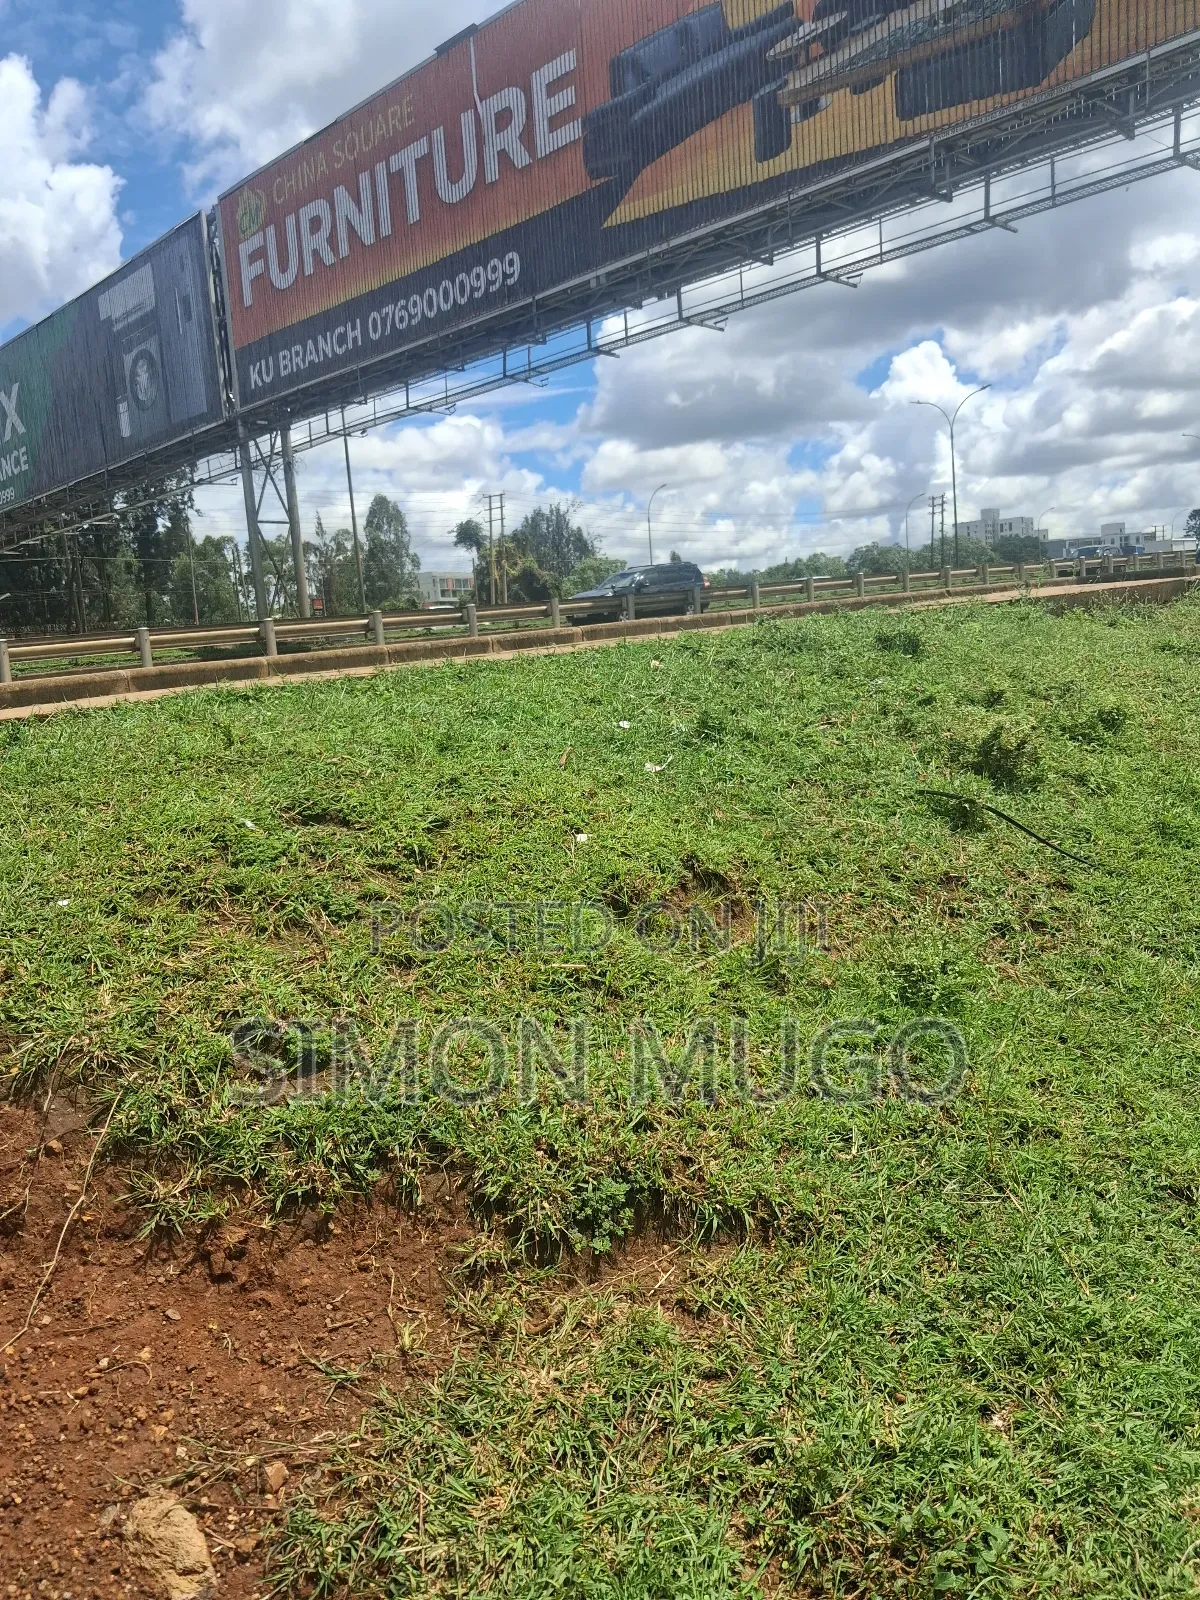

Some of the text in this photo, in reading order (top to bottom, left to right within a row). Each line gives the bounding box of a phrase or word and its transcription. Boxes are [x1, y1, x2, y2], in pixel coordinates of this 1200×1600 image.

[238, 48, 583, 308] FURNITURE
[272, 93, 415, 205] CHINA SQUARE
[250, 251, 520, 389] KU BRANCH 0769000999
